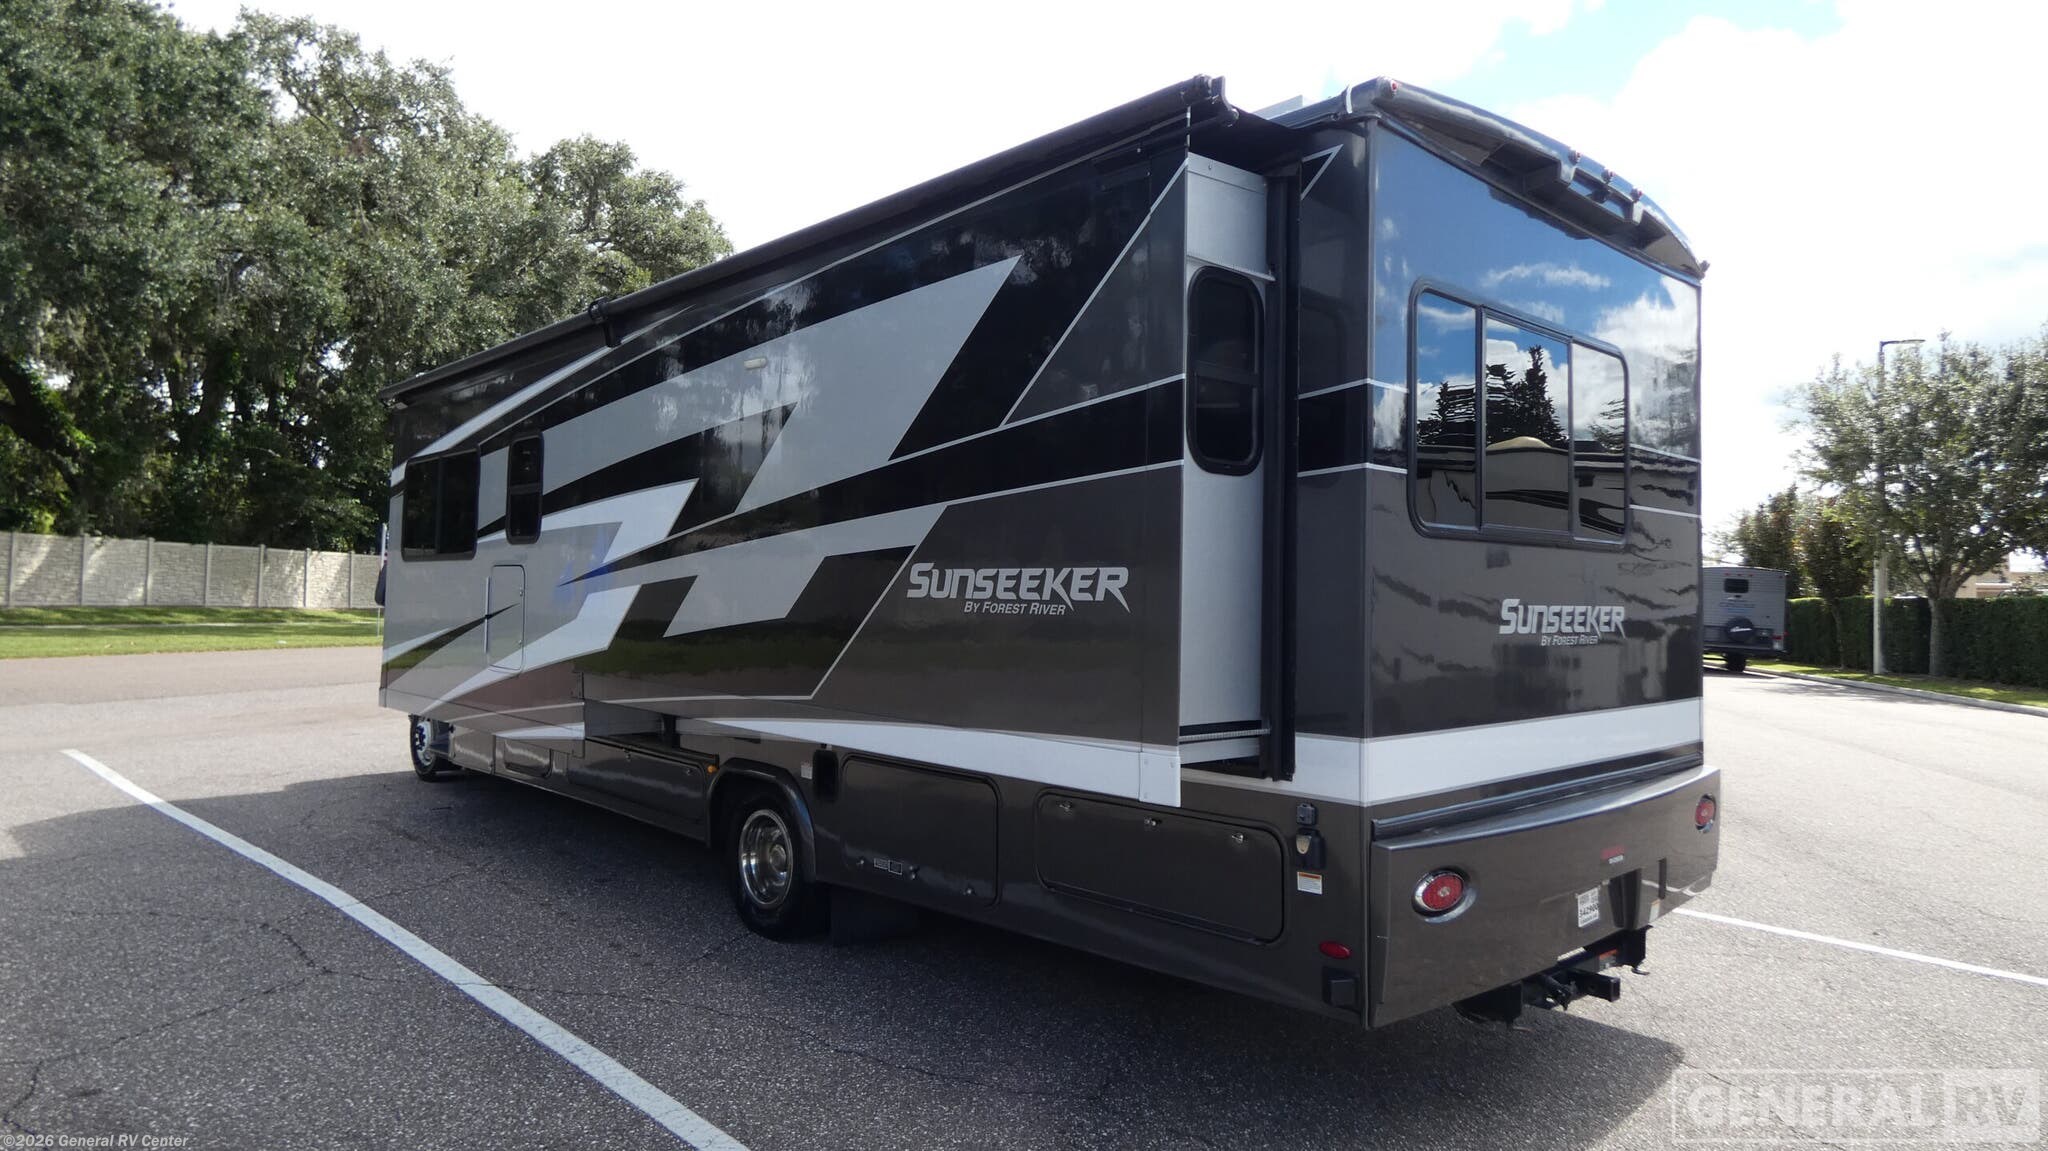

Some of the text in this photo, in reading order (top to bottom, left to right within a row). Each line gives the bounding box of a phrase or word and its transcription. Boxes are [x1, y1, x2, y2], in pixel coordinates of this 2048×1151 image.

[907, 562, 1131, 613] SUNSEEKER
[964, 601, 1066, 615] BY FOREST RIVER
[1499, 598, 1626, 638] SUNSEEKER
[1541, 635, 1599, 646] BY FOREST RIVER
